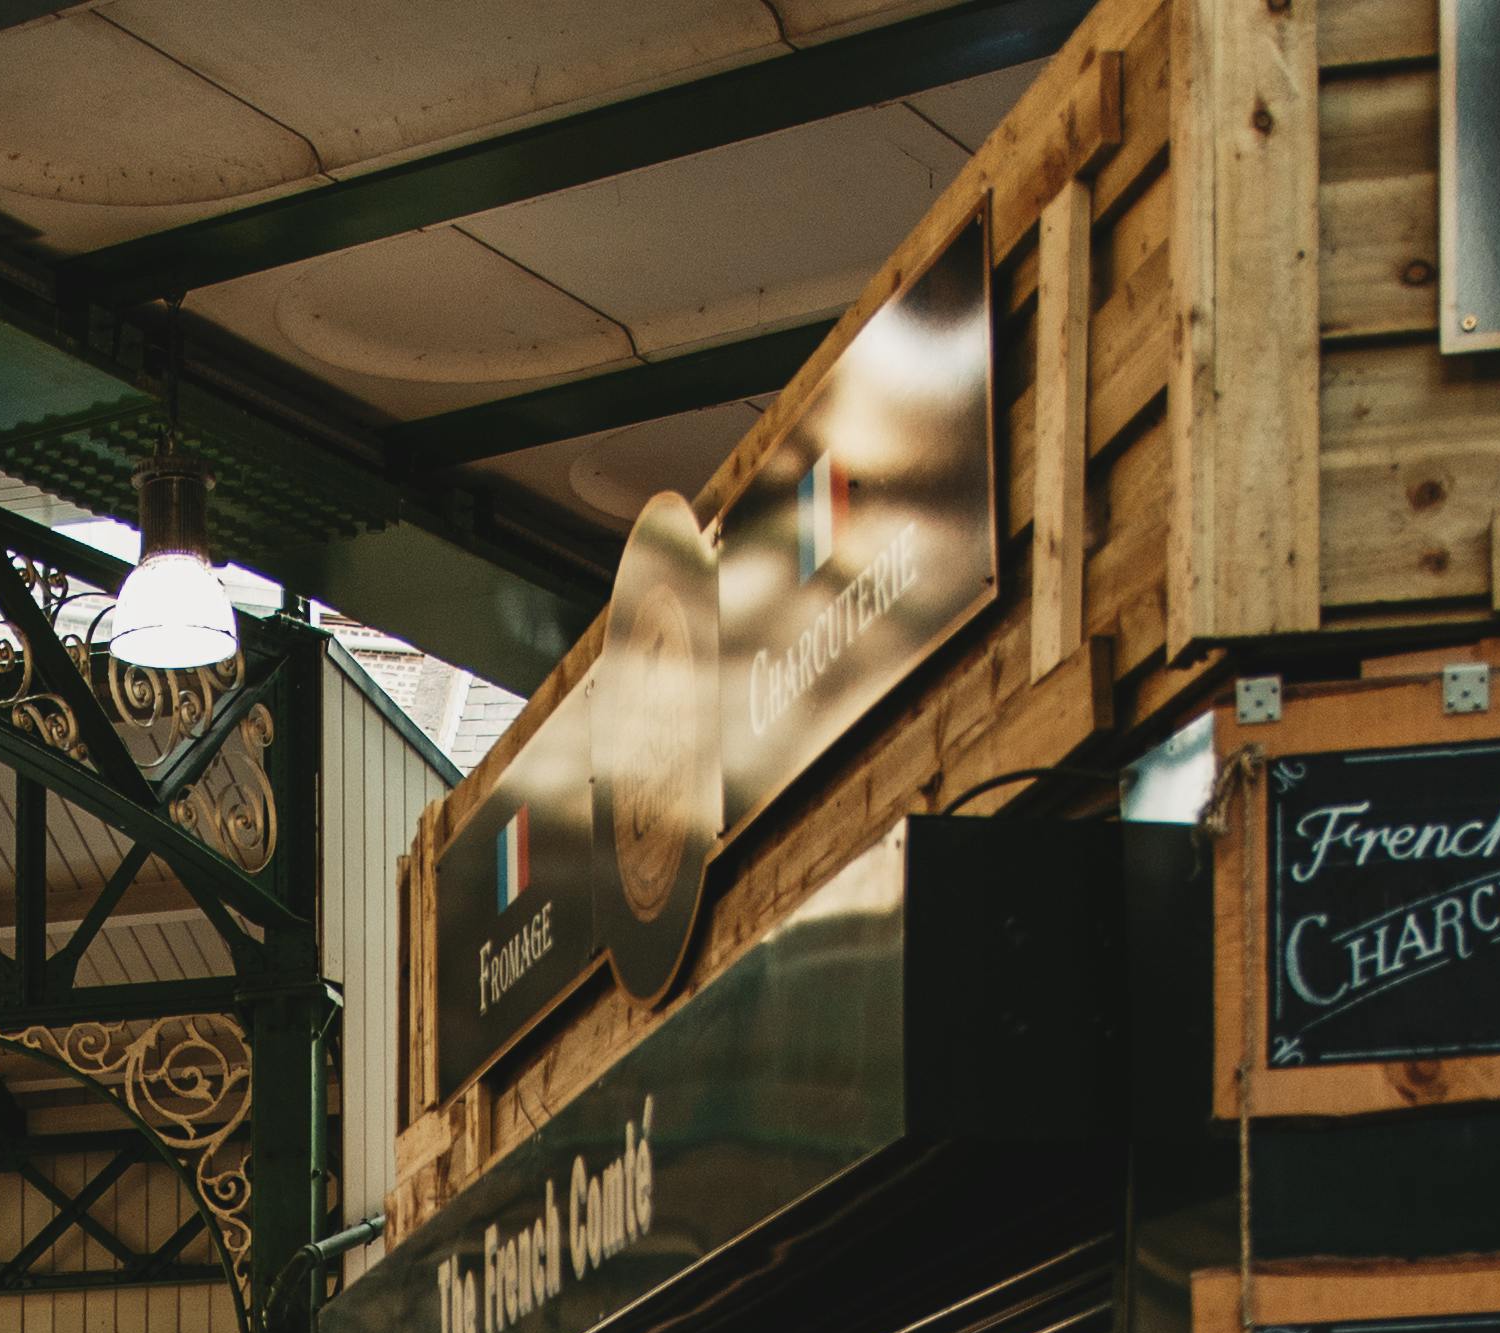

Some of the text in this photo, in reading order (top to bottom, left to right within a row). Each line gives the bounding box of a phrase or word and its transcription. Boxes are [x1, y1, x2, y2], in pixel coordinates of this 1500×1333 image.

[748, 522, 920, 738] CHARCUTERIE
[478, 901, 555, 1018] FROMAGE
[484, 1180, 561, 1333] French
[569, 1093, 654, 1280] Comté
